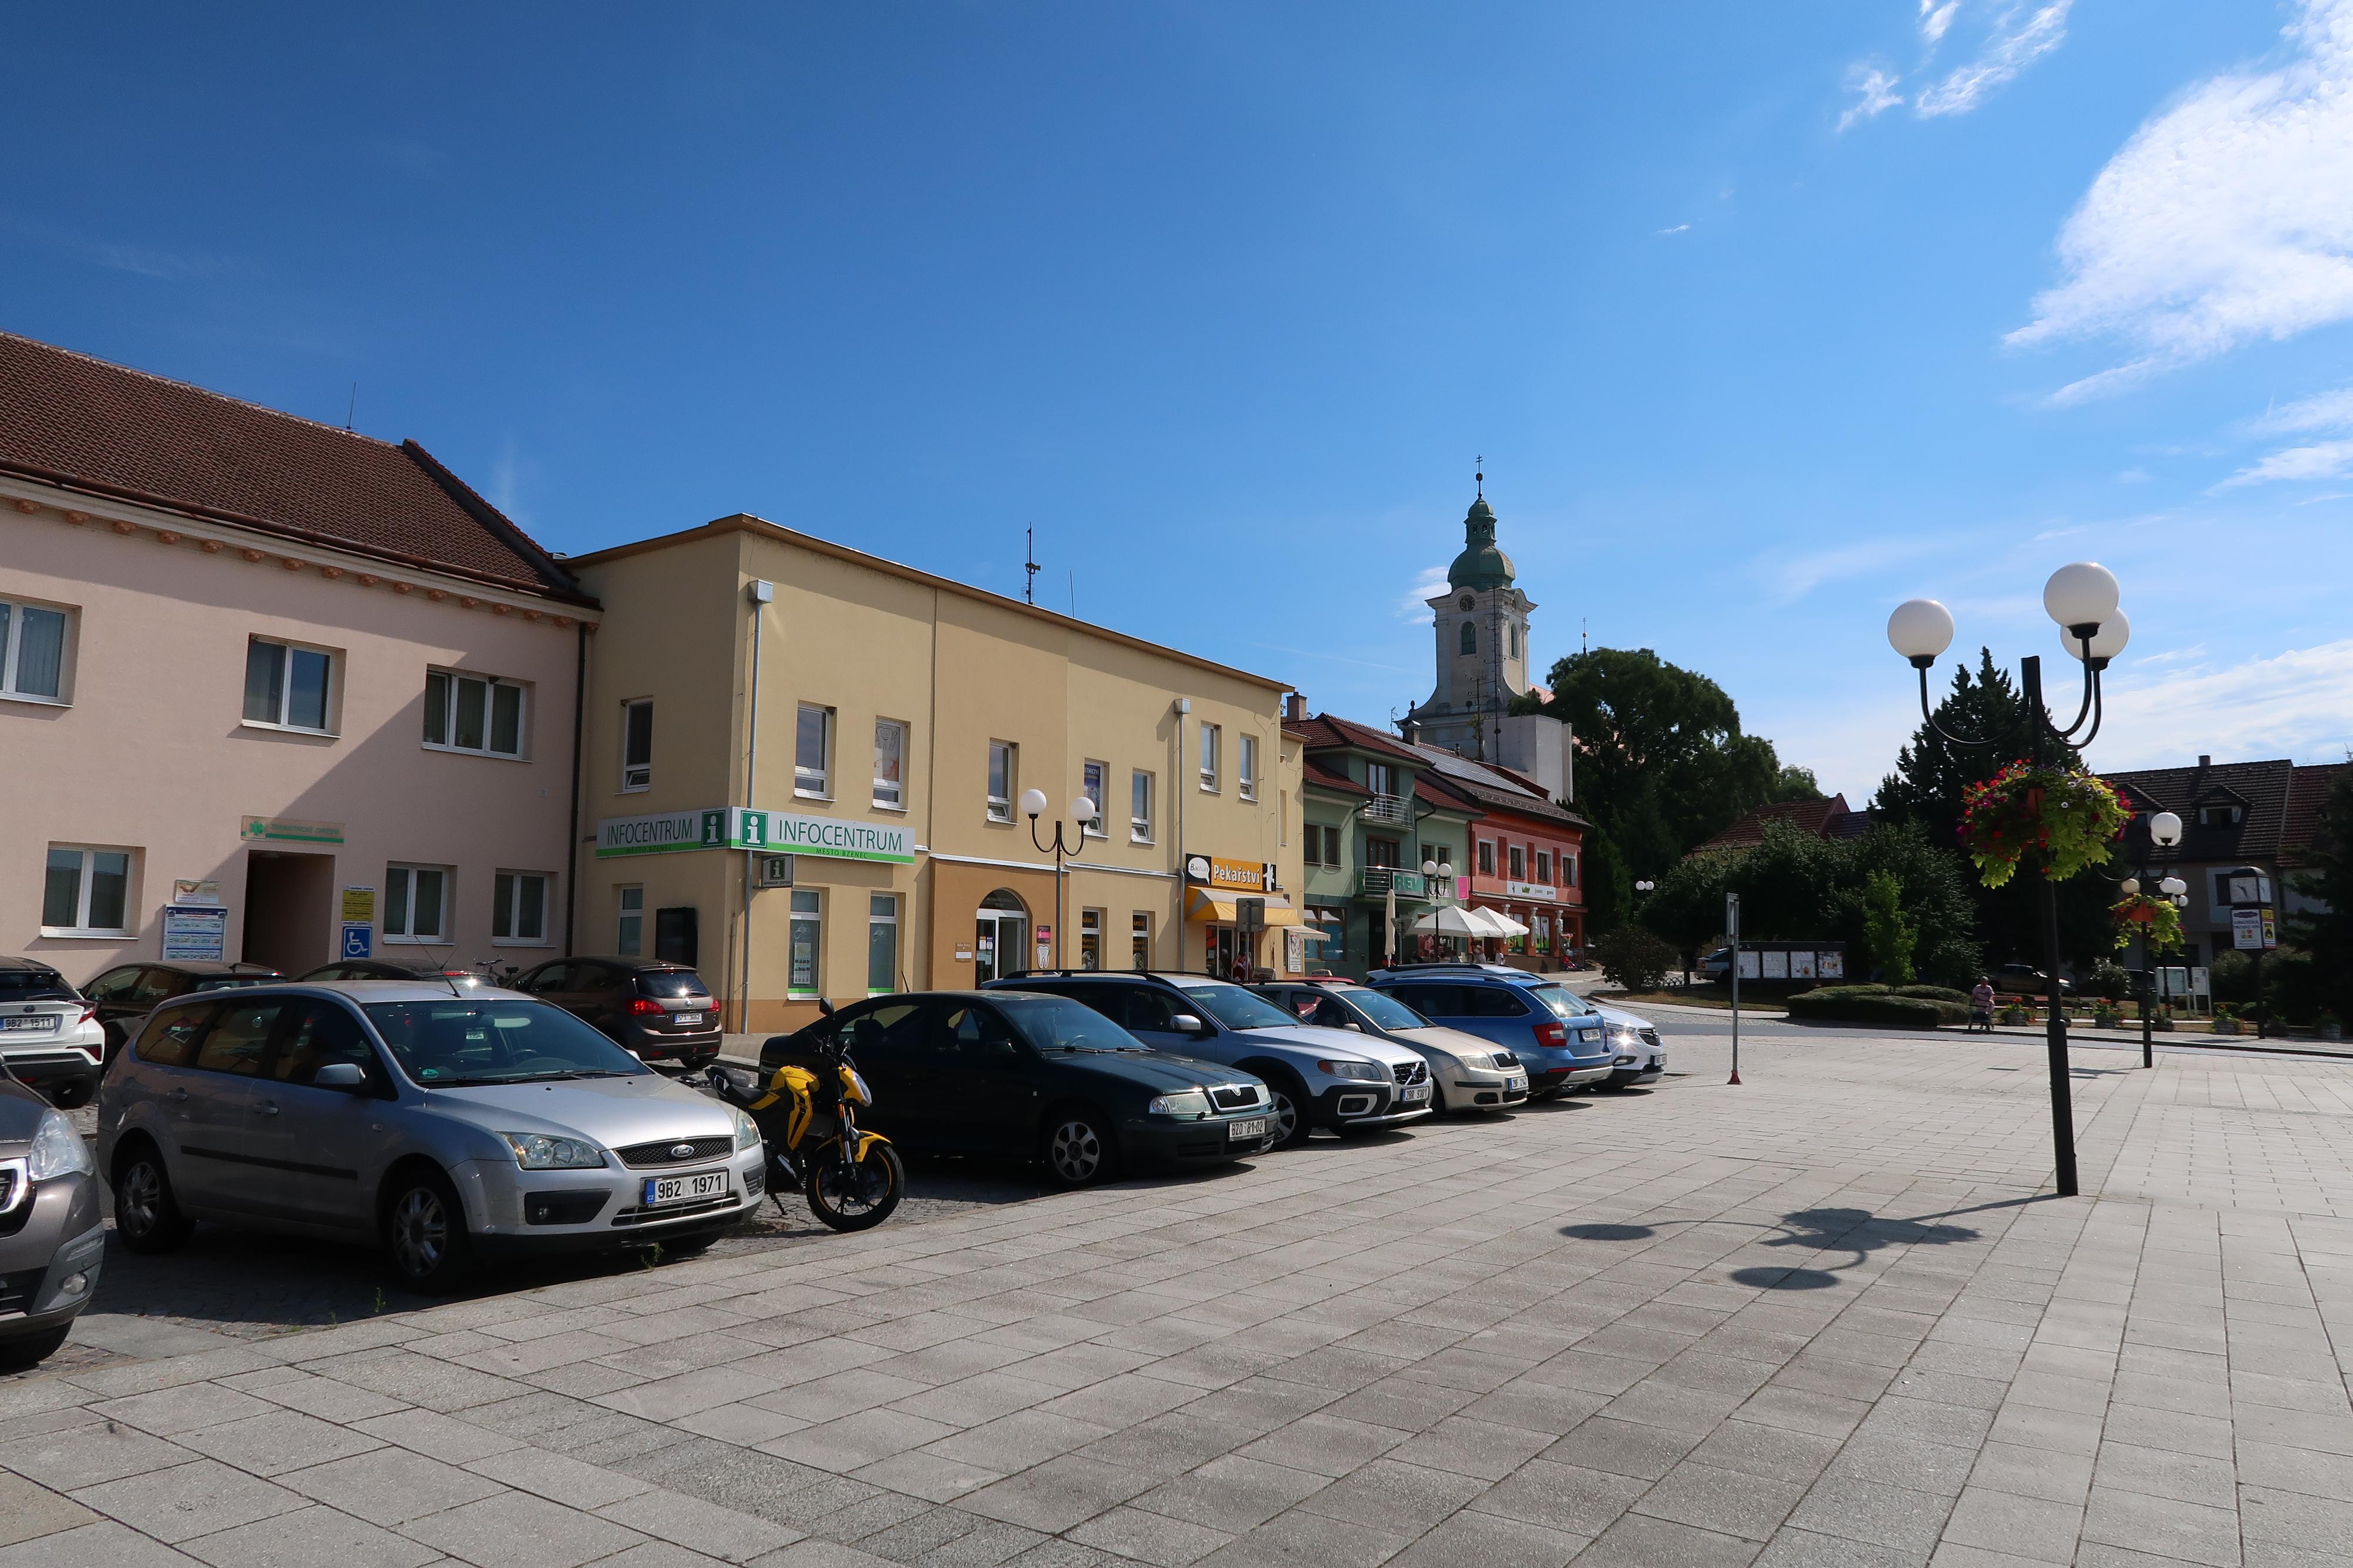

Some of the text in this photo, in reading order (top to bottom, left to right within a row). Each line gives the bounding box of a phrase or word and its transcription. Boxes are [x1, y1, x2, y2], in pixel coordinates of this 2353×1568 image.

[608, 818, 692, 845] INFOCENTRUM
[779, 820, 902, 852] INFOCENTRUM
[649, 843, 672, 852] BZENEC
[1214, 865, 1261, 884] Pekařství
[5, 1018, 51, 1027] 9B2 1511
[657, 1174, 722, 1199] 9B2 1971
